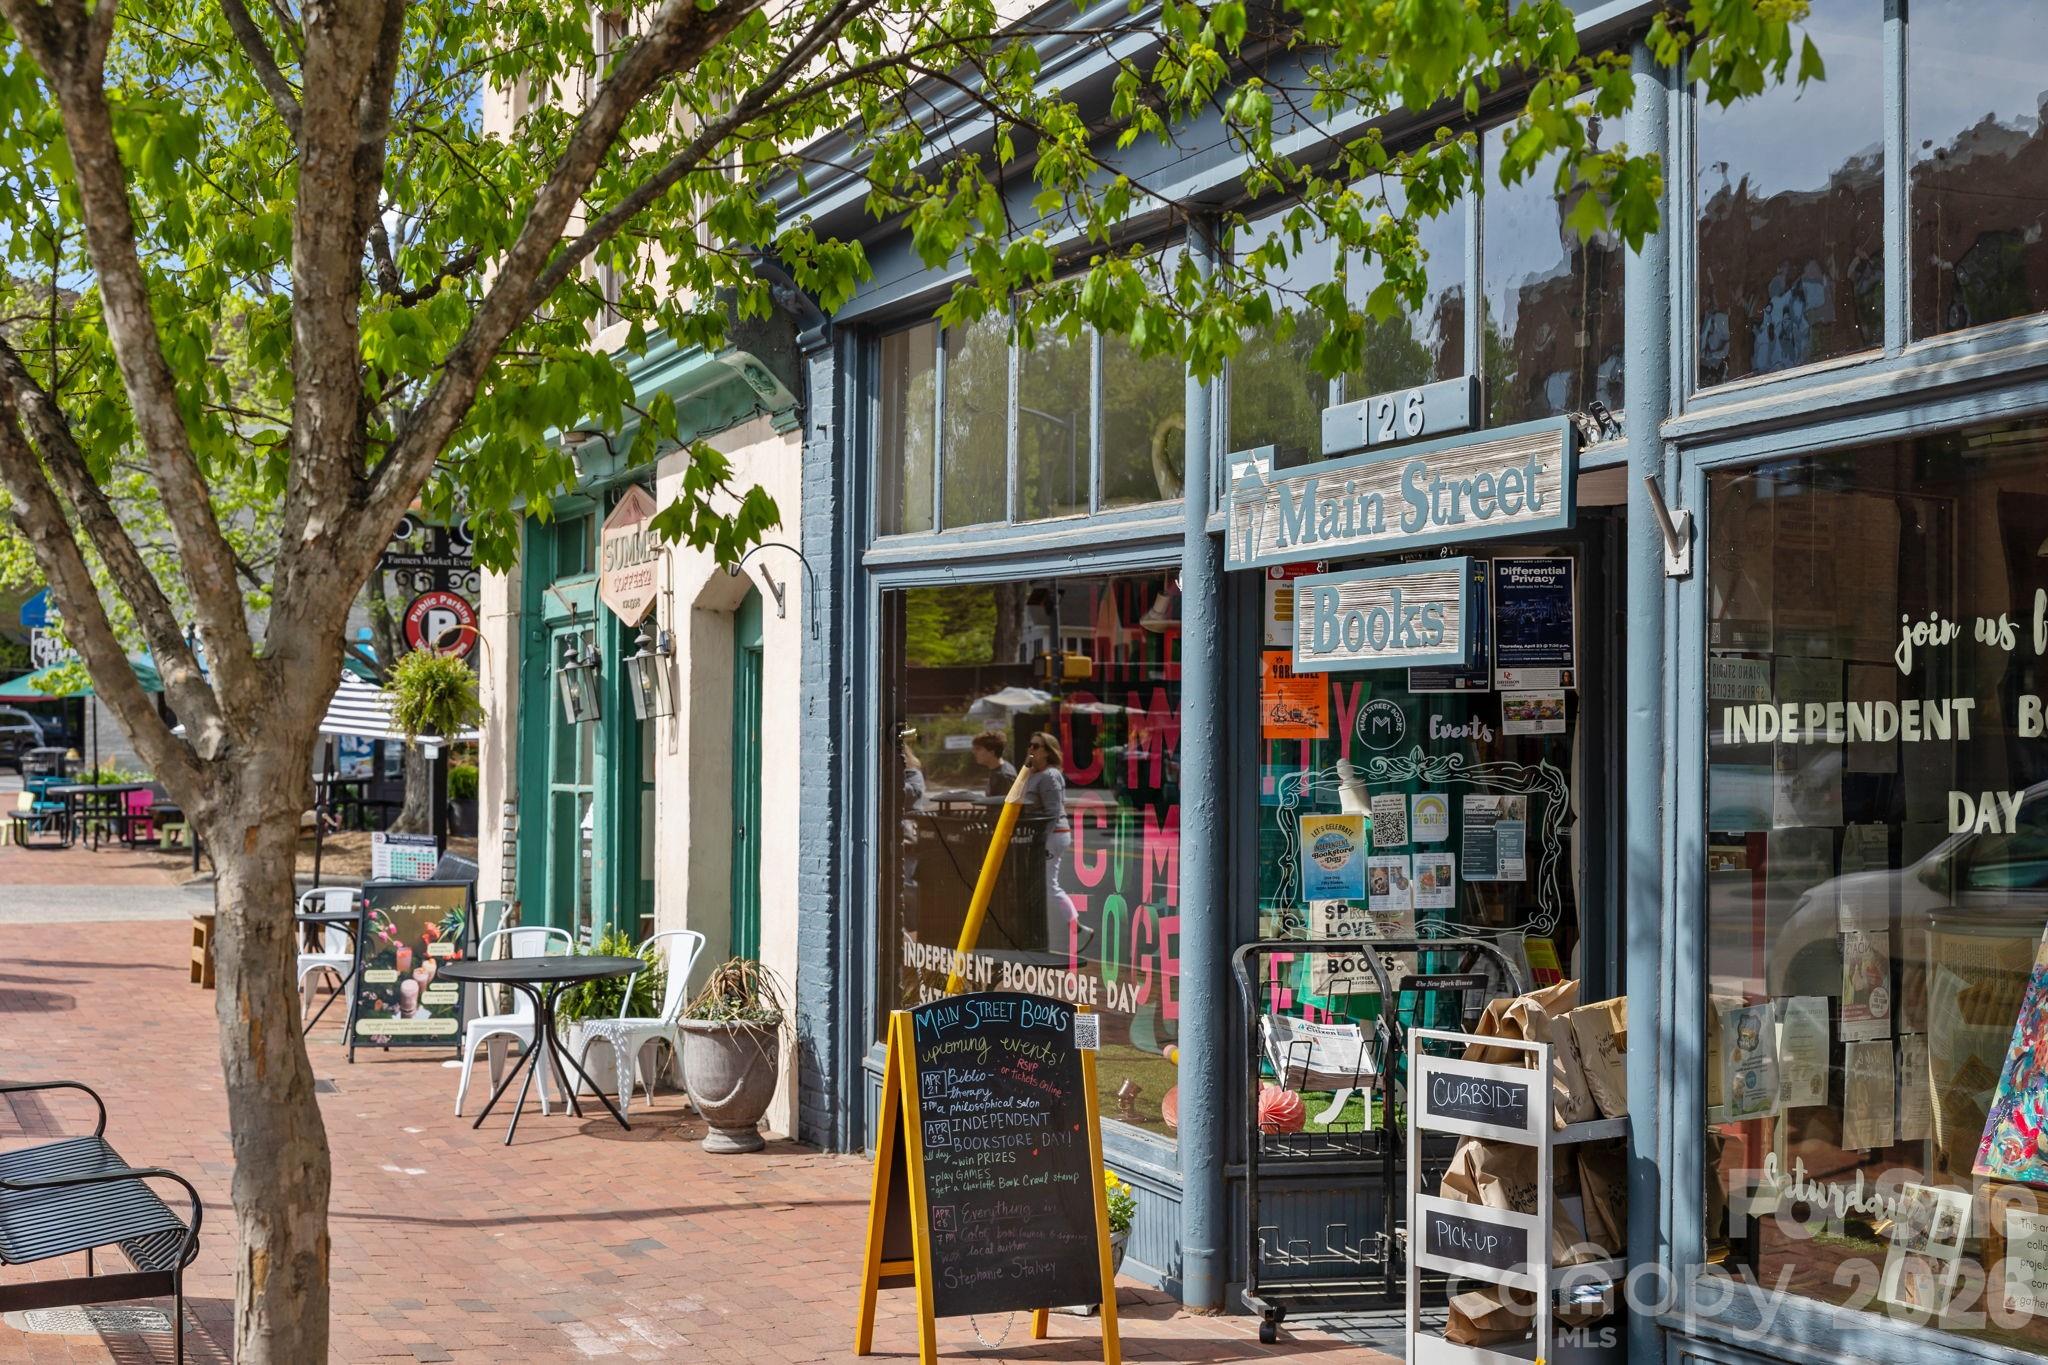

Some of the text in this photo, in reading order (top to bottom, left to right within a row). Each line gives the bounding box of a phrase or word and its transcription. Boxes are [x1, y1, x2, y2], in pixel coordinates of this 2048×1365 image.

[1357, 390, 1424, 446] 126
[1276, 452, 1544, 548] Main Street
[388, 555, 421, 564] Farmers
[422, 556, 451, 566] Market
[1500, 566, 1566, 576] Differential
[1511, 574, 1556, 585] Privacy
[411, 595, 470, 624] Public Parking
[1312, 587, 1445, 654] Books
[1895, 611, 1961, 676] join
[1974, 612, 2020, 651] us
[1360, 703, 1402, 732] MAIN STREET BOOKS
[1723, 694, 2048, 745] INDEPENDENT B
[1428, 714, 1494, 743] Events
[1948, 790, 2025, 834] DAY
[1310, 823, 1355, 838] LET'S CELEBRATE
[1311, 846, 1355, 859] Bookstore
[1325, 856, 1342, 864] Day
[391, 902, 441, 914] spring menu
[903, 941, 1141, 1014] INDEPENDENT BOOKSTORE DAY
[1440, 980, 1455, 988] York
[915, 999, 1070, 1042] MAIN STREET BOOKS
[1306, 1025, 1337, 1036] Citizen
[922, 1036, 992, 1065] upcoming
[1017, 1057, 1040, 1073] RSVP
[924, 1074, 941, 1085] APR
[927, 1085, 939, 1095] 21
[948, 1087, 992, 1101] therapy
[1433, 1078, 1526, 1108] CURBSIDE
[937, 1104, 946, 1114] a
[949, 1099, 1014, 1116] philosophical
[927, 1122, 948, 1135] APR
[951, 1111, 1051, 1132] INDEPENDENT
[931, 1134, 945, 1144] 25
[953, 1133, 1033, 1153] BOOKSTORE
[935, 1150, 951, 1164] day
[977, 1151, 1017, 1165] PRIZES
[955, 1168, 992, 1181] GAMES
[999, 1176, 1020, 1190] Book
[1022, 1172, 1049, 1187] Crawl
[1052, 1171, 1080, 1185] stamp
[961, 1200, 1033, 1224] Everything
[2020, 1217, 2037, 1231] This
[1436, 1220, 1498, 1254] PICK-UP
[2026, 1240, 2048, 1252] colla
[944, 1256, 1057, 1289] Stephanie Stalvey
[2020, 1257, 2048, 1272] projec
